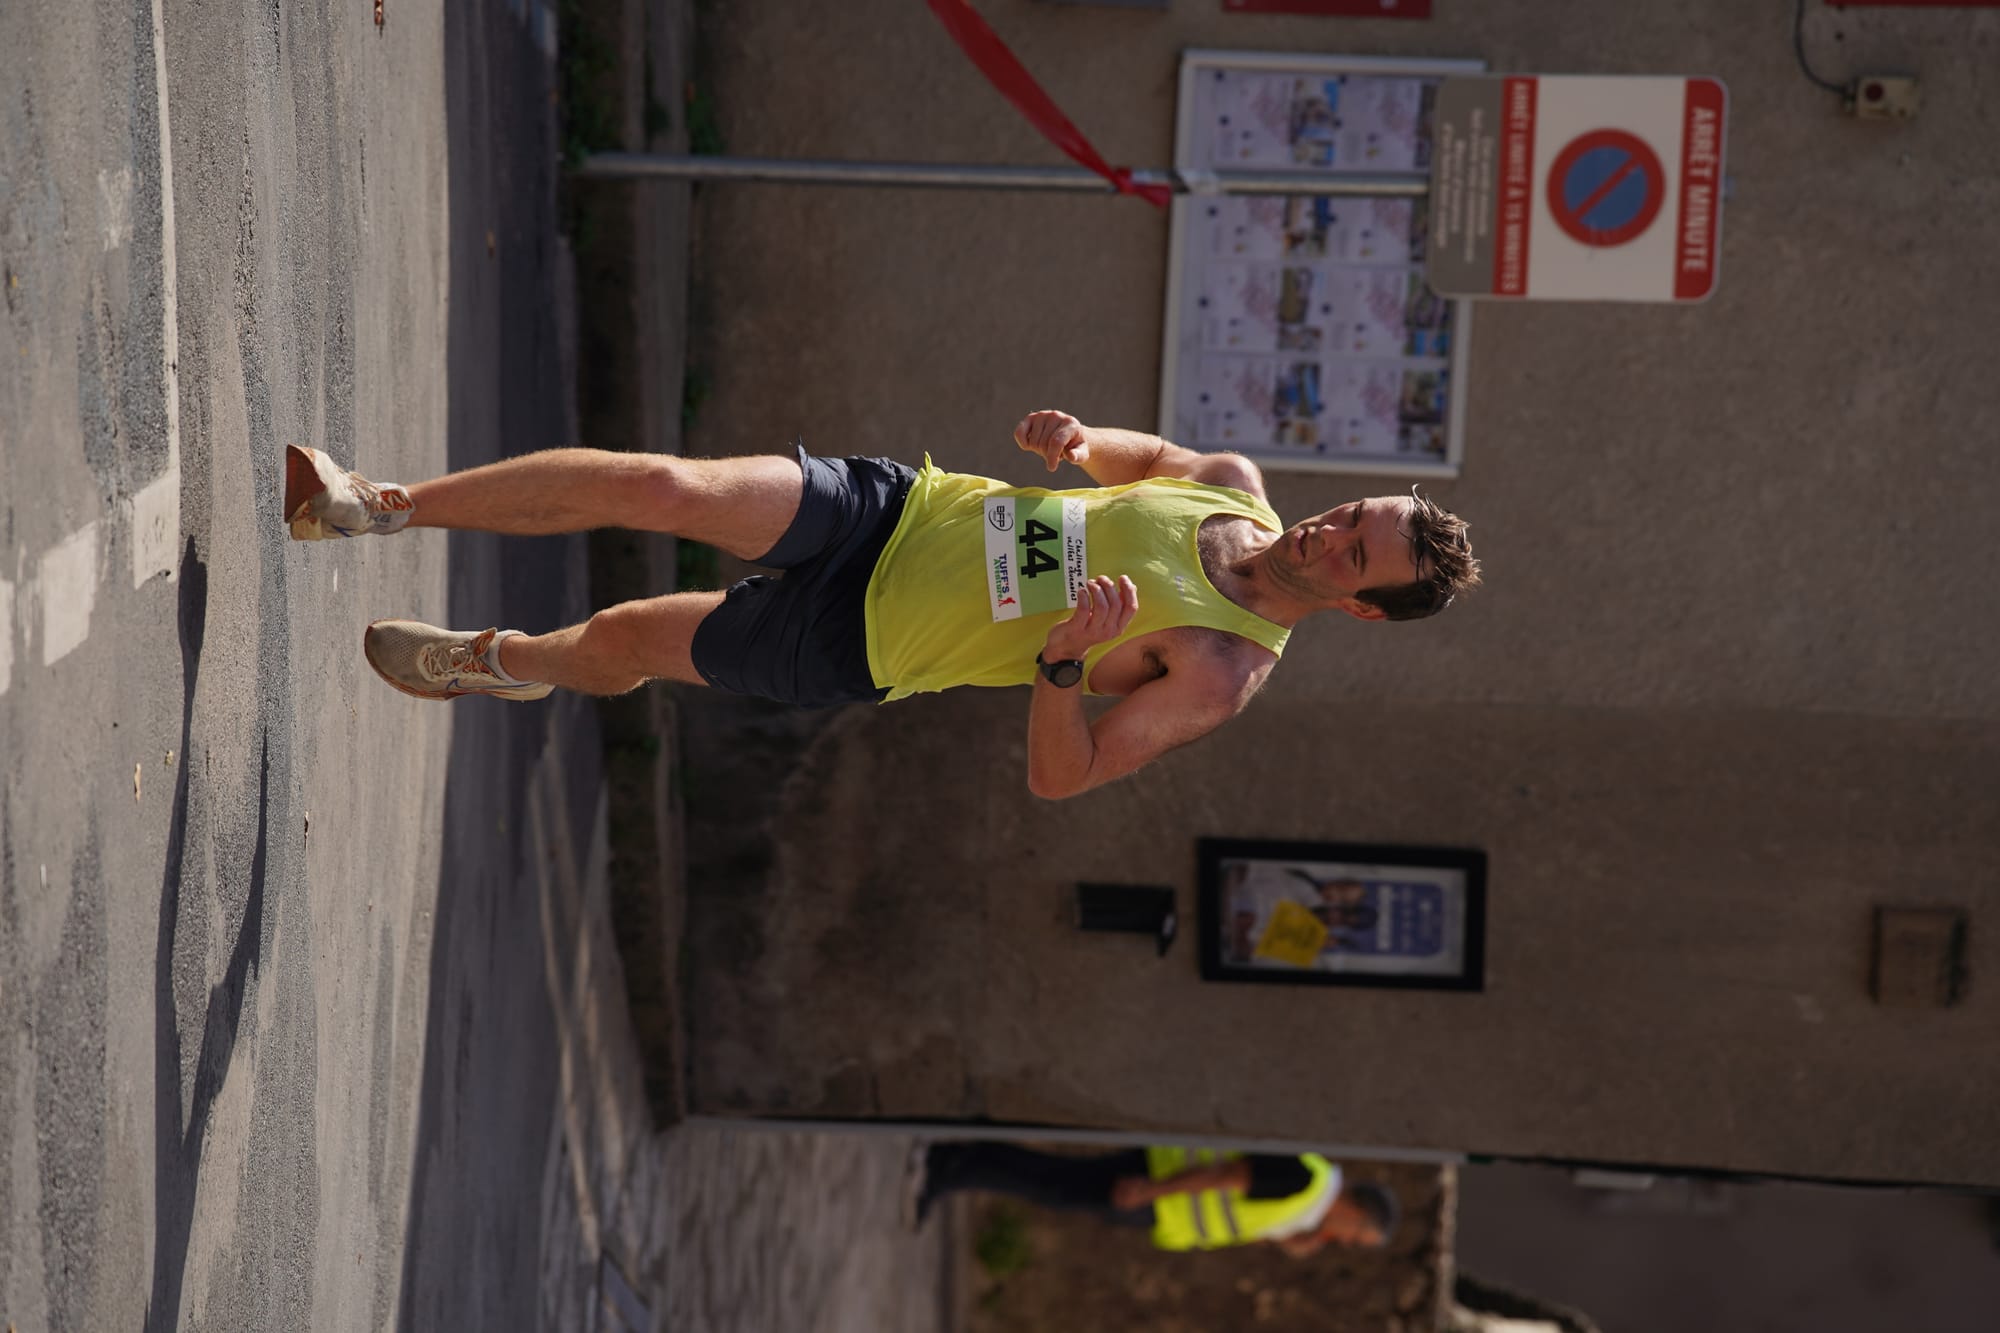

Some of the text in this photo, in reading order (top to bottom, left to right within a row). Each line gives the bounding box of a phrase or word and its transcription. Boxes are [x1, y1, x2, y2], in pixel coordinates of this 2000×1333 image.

[1683, 106, 1718, 272] ARRÊT MINUTE
[996, 505, 1005, 528] BFP
[1019, 520, 1059, 578] 44
[1074, 539, 1083, 577] Challenge
[999, 553, 1010, 594] TUFF'S
